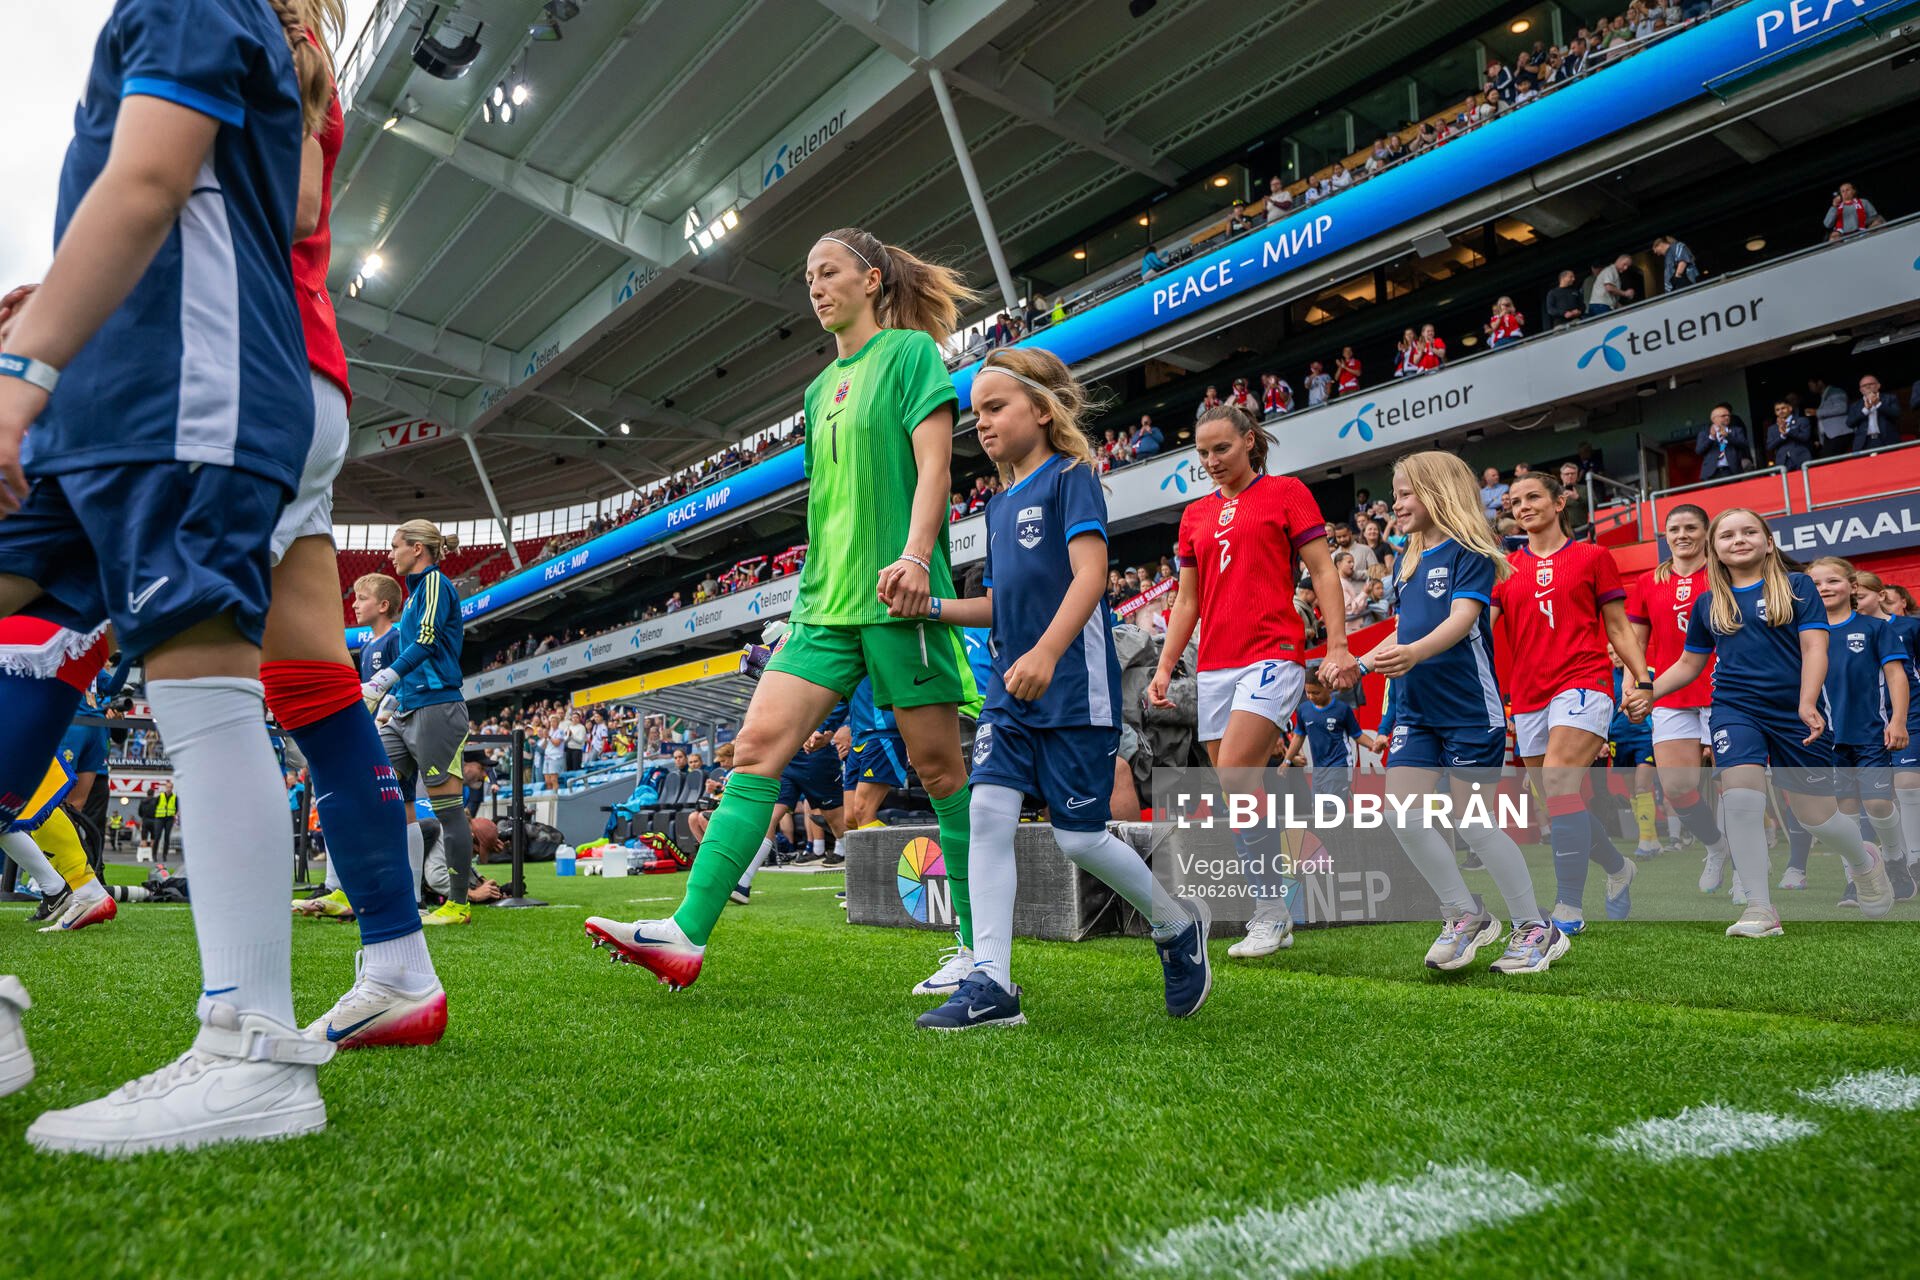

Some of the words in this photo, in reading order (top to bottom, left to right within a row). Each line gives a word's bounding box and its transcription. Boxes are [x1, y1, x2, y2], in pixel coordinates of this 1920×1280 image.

[787, 109, 846, 169] telenor
[1153, 259, 1233, 315] PEACE
[1263, 215, 1332, 268] МИР
[1627, 297, 1763, 355] telenor
[1375, 384, 1473, 428] telenor
[832, 422, 838, 464] 1
[667, 501, 697, 528] PEACE
[705, 487, 731, 511] МИР
[545, 560, 566, 580] PEACE
[1218, 539, 1232, 574] 2
[760, 589, 793, 608] telenor
[1539, 599, 1555, 630] 4
[695, 609, 723, 627] telenor
[1260, 661, 1278, 688] 2
